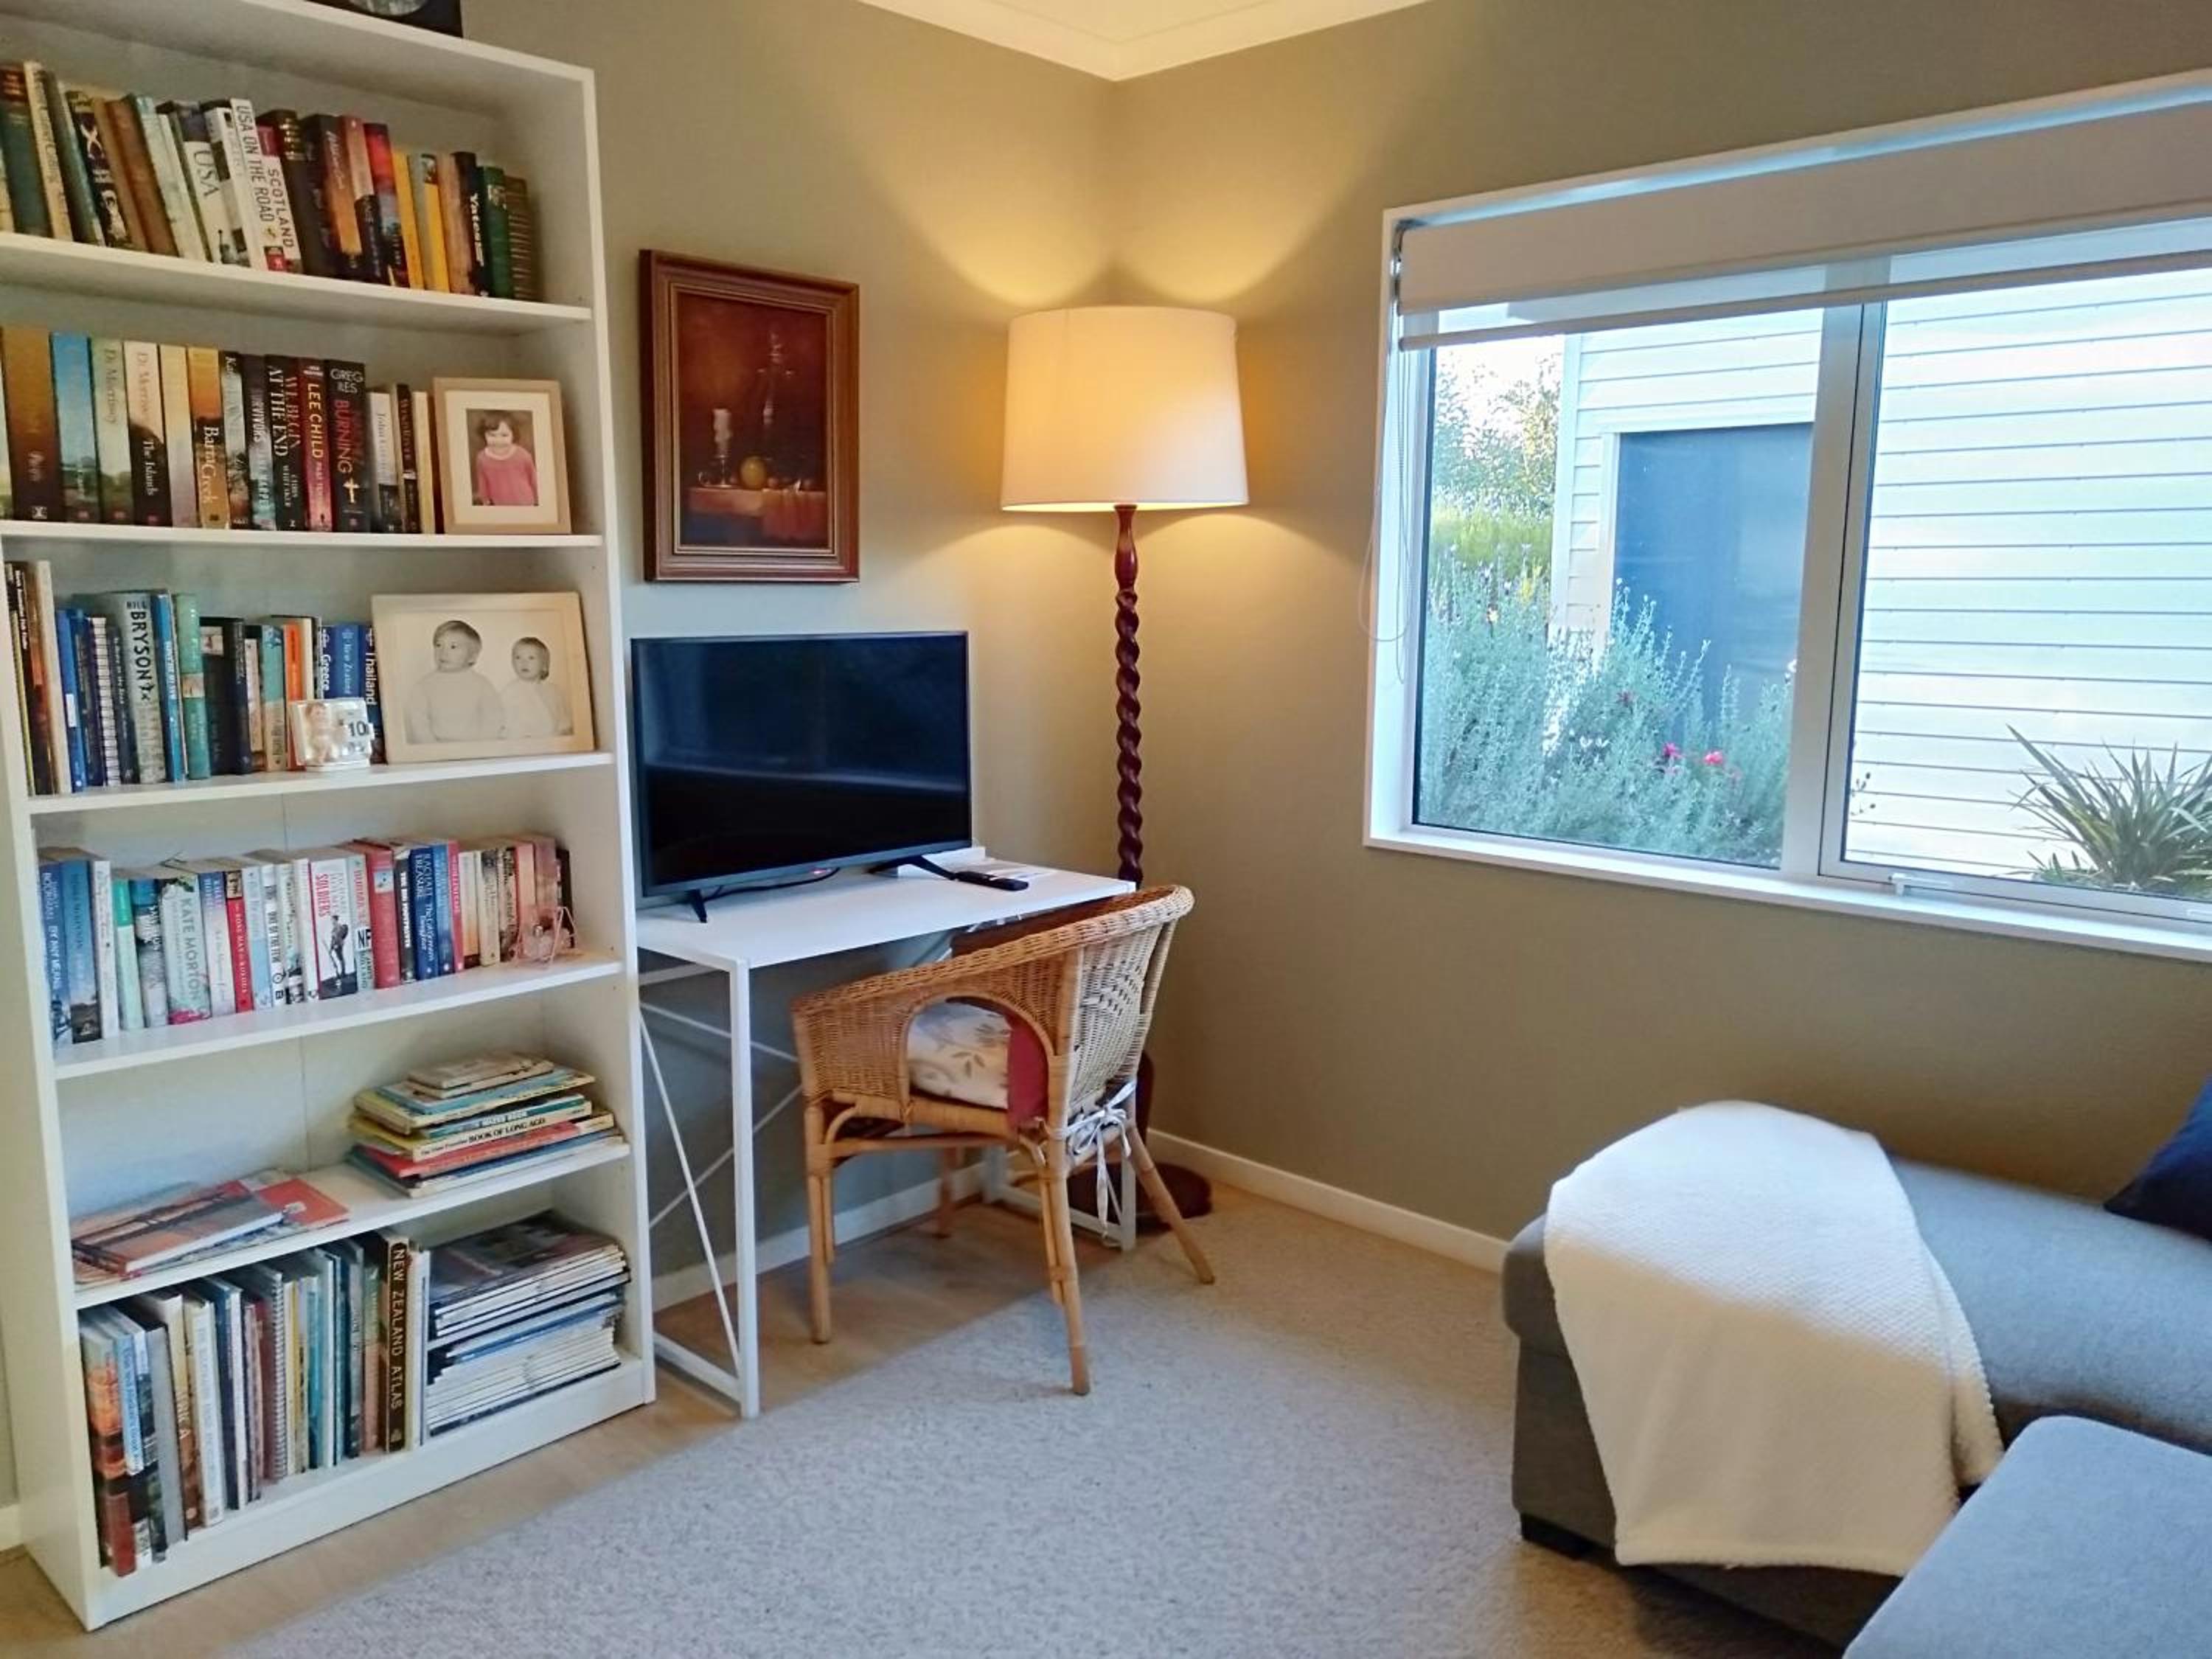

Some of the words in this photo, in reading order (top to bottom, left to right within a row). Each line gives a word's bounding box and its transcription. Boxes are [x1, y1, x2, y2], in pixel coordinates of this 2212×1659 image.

[237, 106, 254, 133] USA
[243, 133, 258, 155] ON
[194, 150, 219, 198] USA
[248, 159, 266, 184] THE
[256, 184, 274, 222] ROAD
[268, 169, 294, 248] SCOTLAND
[268, 366, 282, 385] AT
[330, 369, 364, 381] GREG
[271, 390, 286, 420] THE
[307, 383, 320, 410] LEE
[273, 424, 288, 456] END
[309, 414, 323, 458] CHILD
[334, 399, 353, 473] BURNING
[145, 459, 159, 495] Islands
[131, 611, 153, 683] BRYSON
[321, 654, 332, 691] Greece
[365, 653, 377, 706] Thailand
[181, 898, 194, 933] KATE
[184, 939, 201, 1000] MORTON
[506, 1123, 526, 1133] LONG
[529, 1119, 546, 1127] AGO
[391, 1249, 405, 1279] NEW
[391, 1289, 405, 1357] ZEALAND
[390, 1365, 403, 1409] ATLAS
